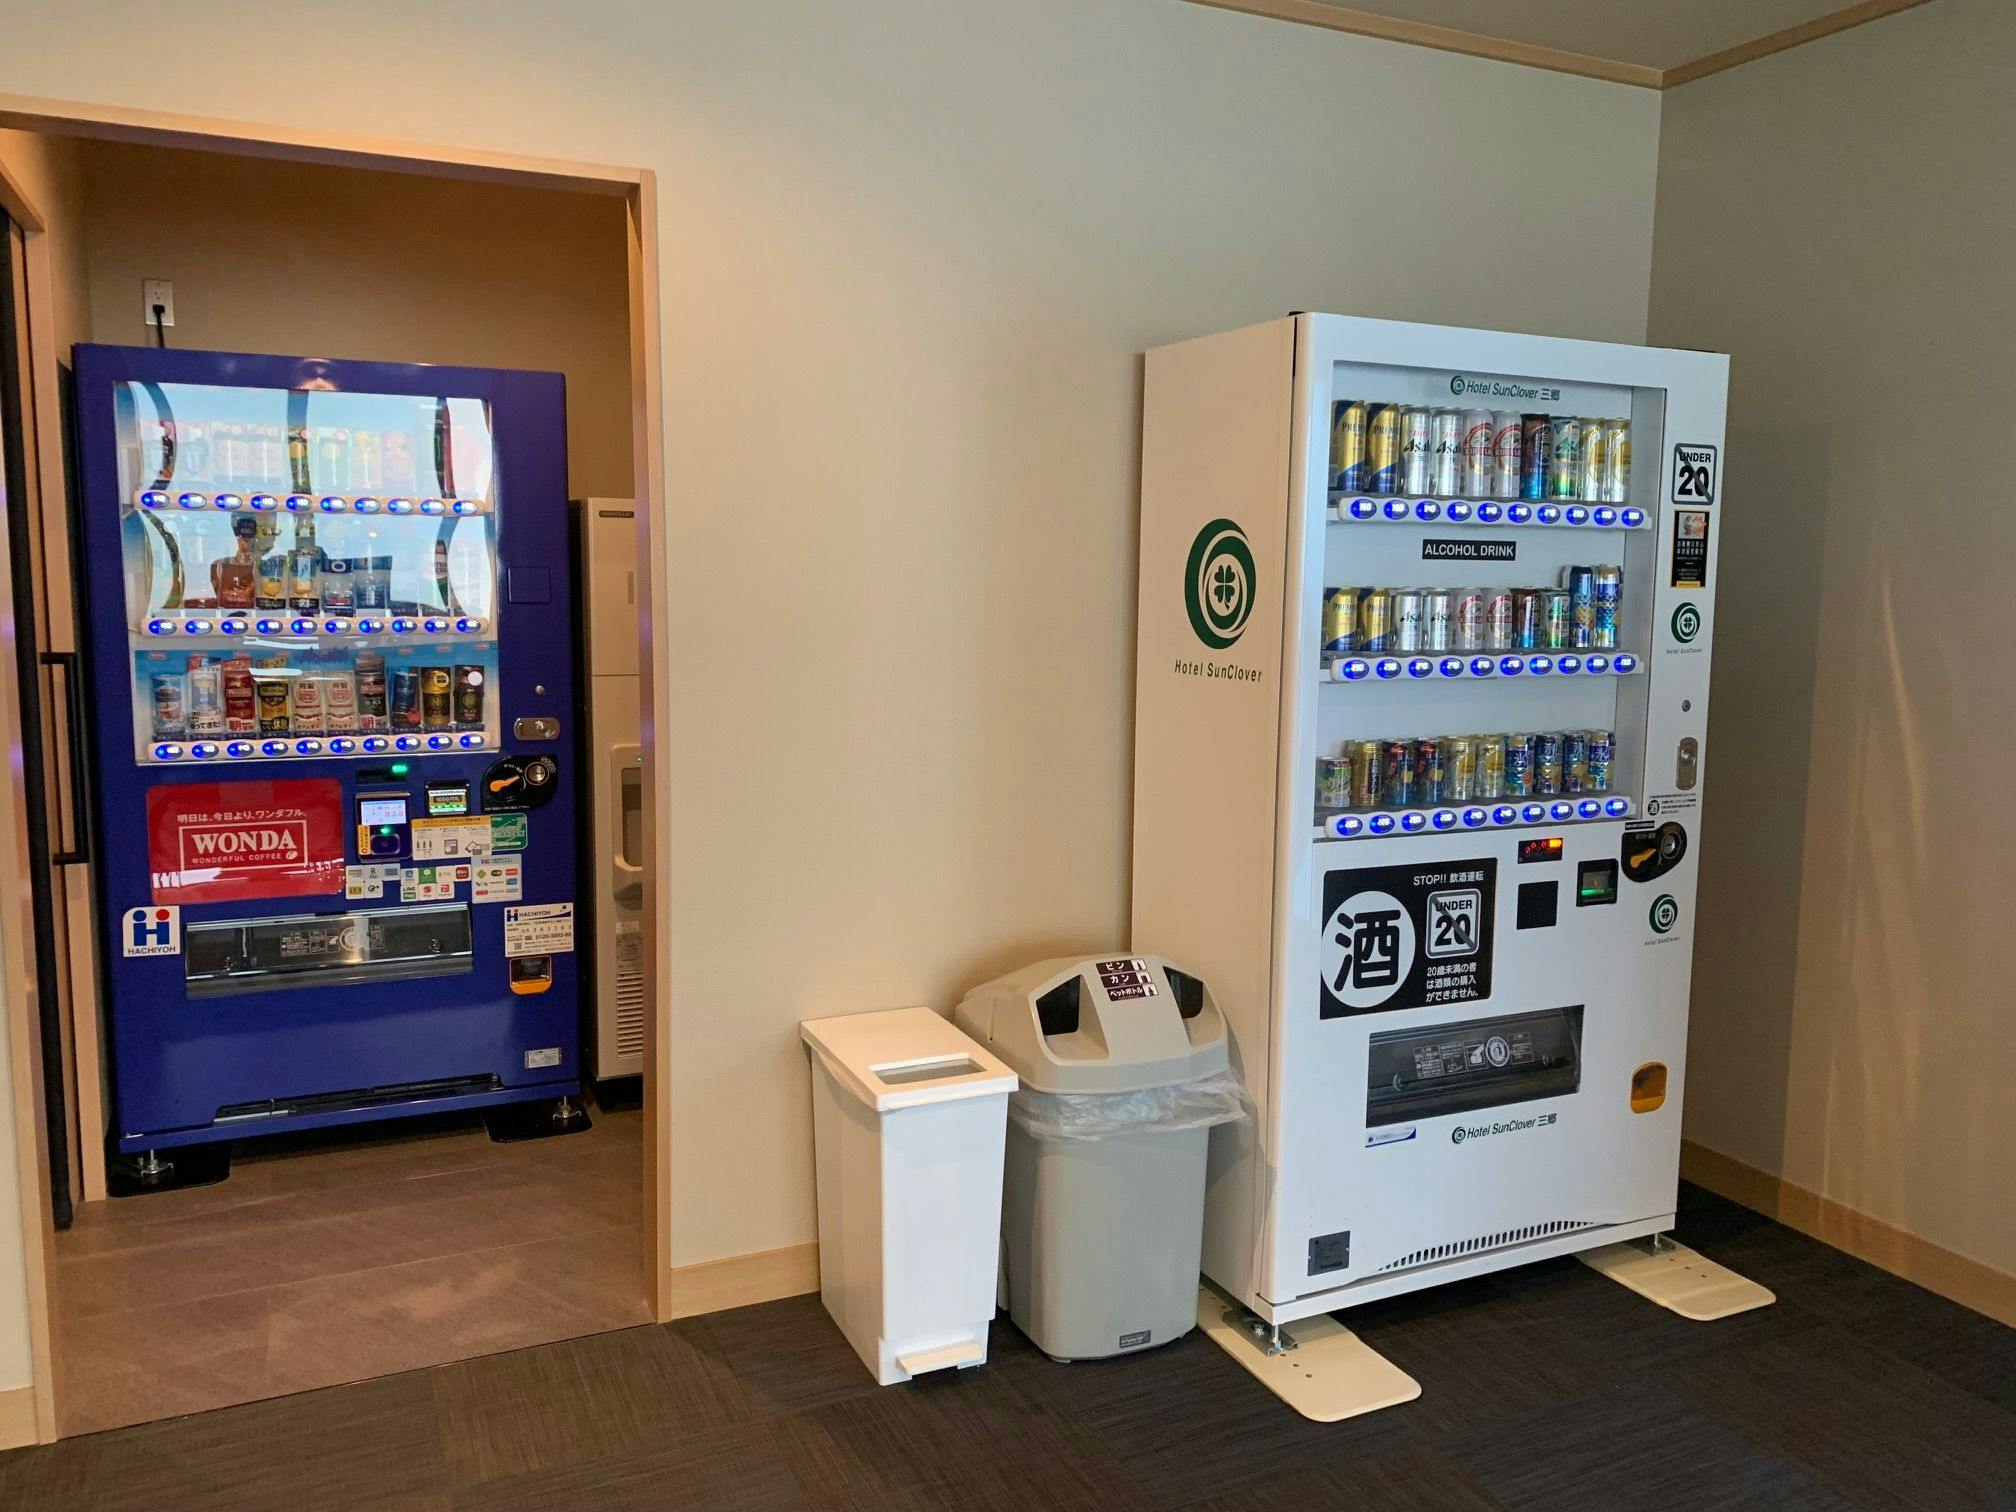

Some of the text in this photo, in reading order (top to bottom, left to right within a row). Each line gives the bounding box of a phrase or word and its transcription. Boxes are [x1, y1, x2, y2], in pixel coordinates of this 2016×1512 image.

[1465, 380, 1492, 395] Hotel
[1492, 383, 1539, 399] SunClover
[1680, 452, 1711, 463] UNDER
[1678, 465, 1710, 497] 20
[1424, 543, 1514, 557] ALCOHOL DRINK
[1172, 659, 1263, 682] Hotel SunClover
[177, 809, 307, 823] 明日は、今日より、ワンダフル。
[191, 829, 298, 855] WONDA
[192, 852, 281, 864] WONDERFUL COFFEE
[1413, 871, 1484, 886] STOP!! 飲酒運転
[519, 905, 551, 917] HACHIYOH
[1436, 899, 1473, 912] UNDER
[1434, 913, 1471, 947] 20
[127, 945, 176, 955] HACHIYOH
[1333, 909, 1402, 992] 酒
[1426, 962, 1477, 977] 20歳未満の者
[1110, 974, 1130, 984] カン
[1426, 974, 1477, 990] は酒類の購入
[1110, 987, 1144, 997] ペットボトル
[1425, 986, 1479, 1003] ができません。
[1467, 1125, 1491, 1139] Hotel
[1492, 1119, 1537, 1135] SunClover
